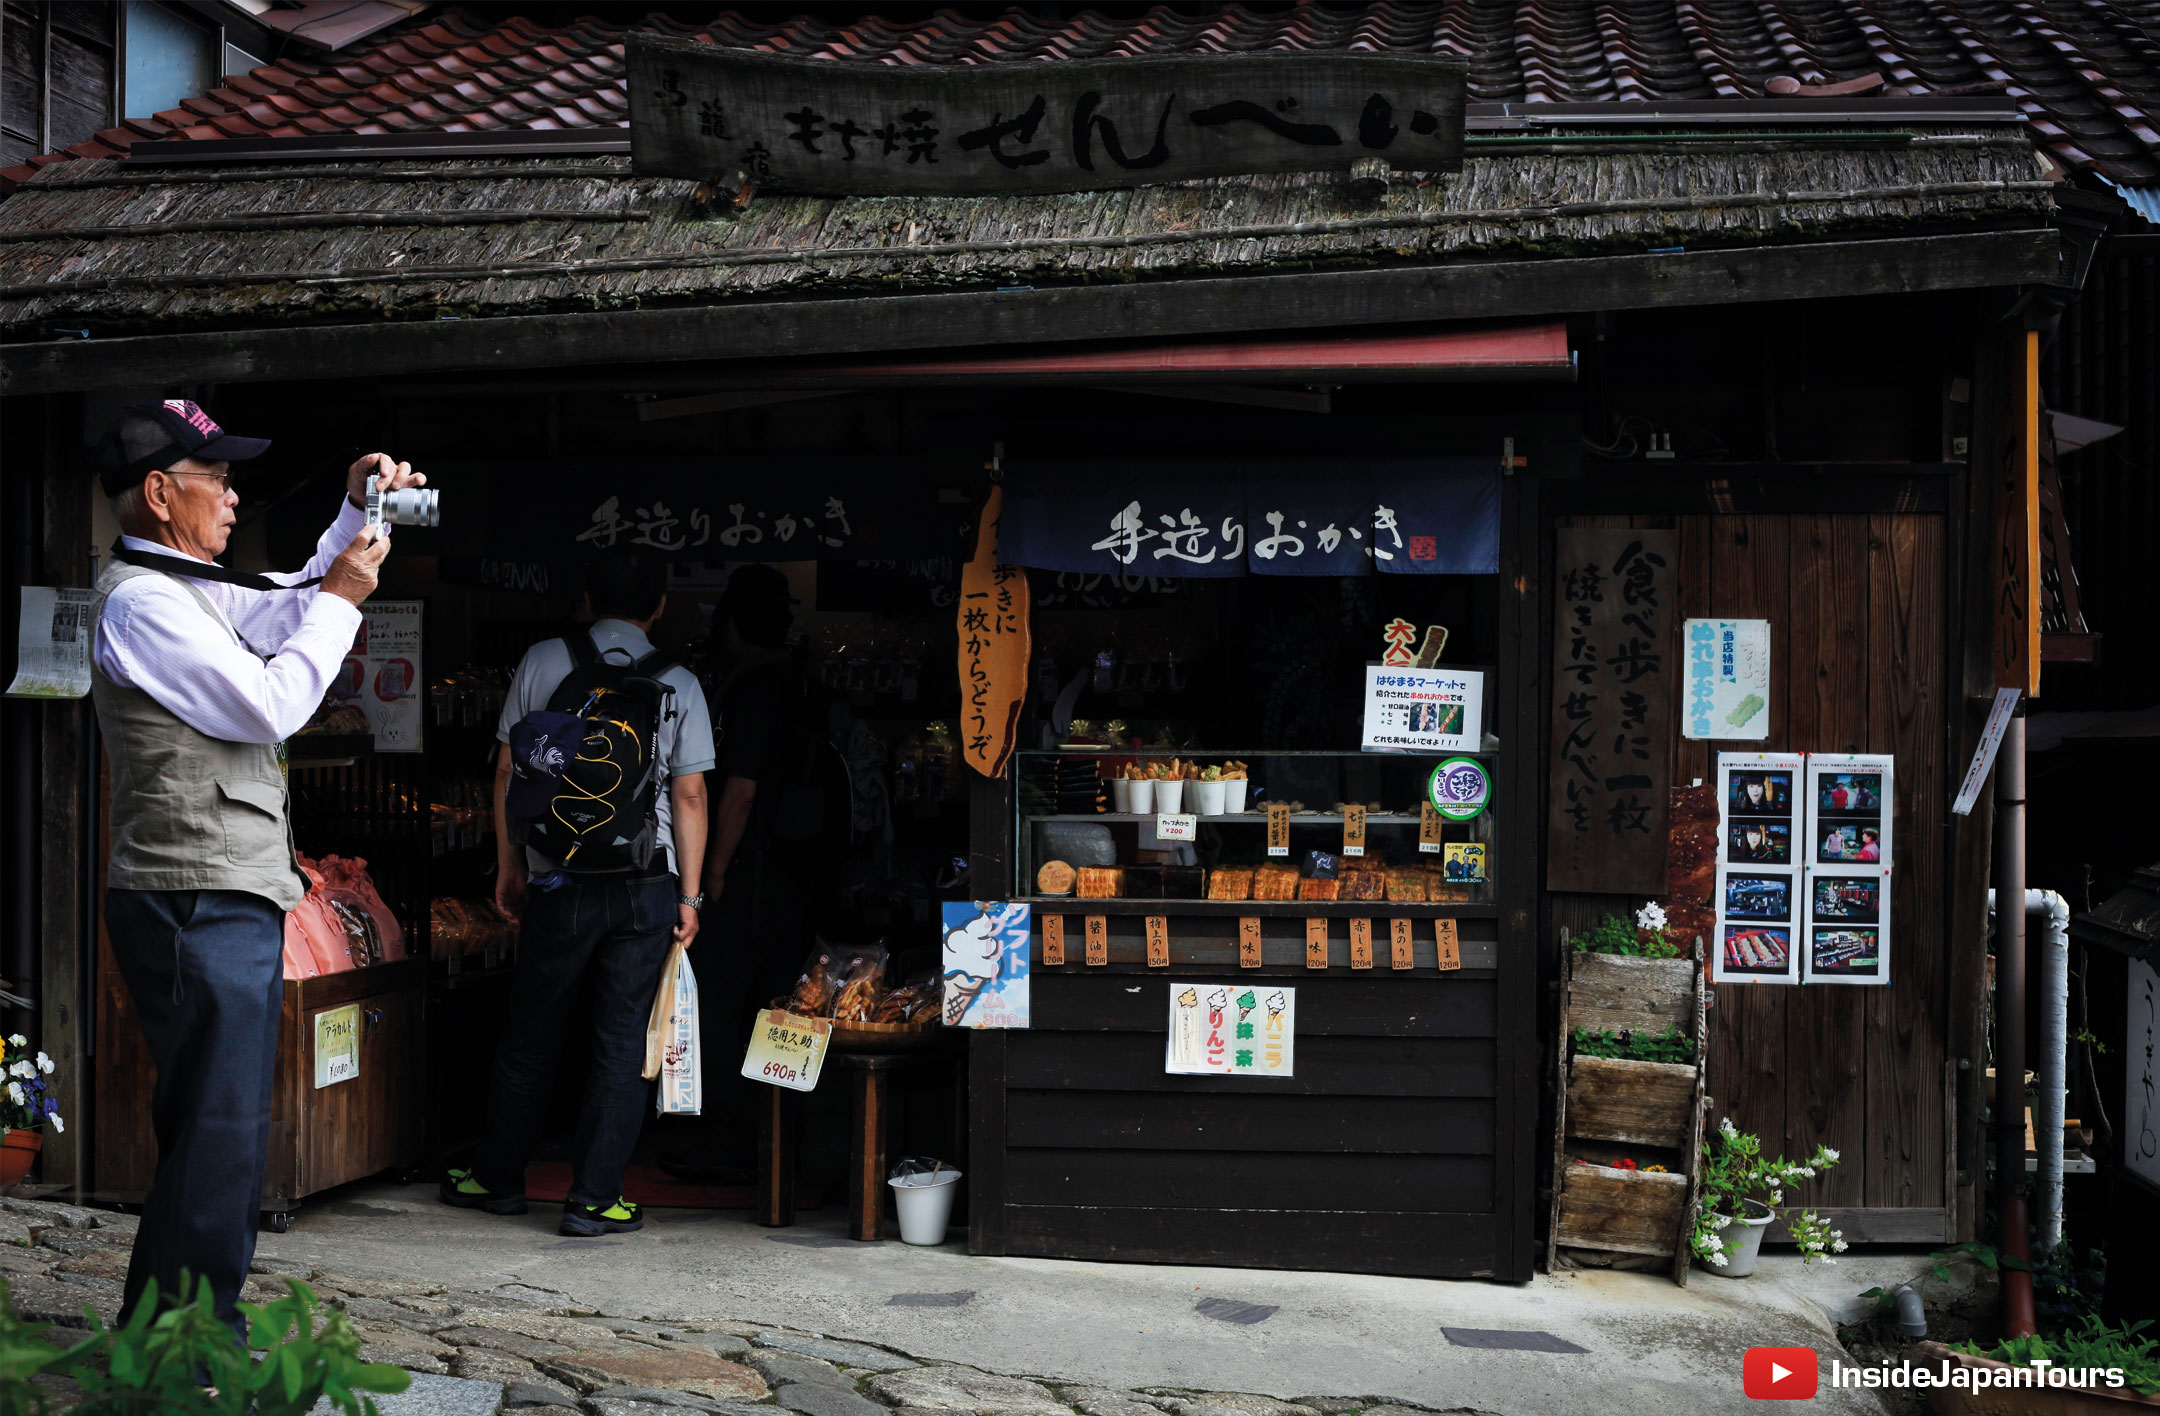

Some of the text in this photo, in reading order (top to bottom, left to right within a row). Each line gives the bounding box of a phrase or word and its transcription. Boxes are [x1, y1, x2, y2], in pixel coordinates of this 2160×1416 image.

[786, 91, 1439, 171] もち焼 せんべい
[576, 496, 853, 551] 手造りおかき
[1091, 500, 1404, 565] 手造りおかき
[1722, 630, 1734, 676] 当店特製
[963, 592, 992, 760] 一枚からどうぞ
[1376, 675, 1466, 690] はなまるマーケットで
[1605, 540, 1666, 835] 食べ歩きに一枚
[1347, 811, 1359, 840] 七味
[1007, 905, 1029, 974] ソフト
[1048, 918, 1058, 952] ざらめ
[1090, 920, 1102, 951] 醤油
[1149, 918, 1162, 956] 特上のり
[1242, 923, 1255, 953] 七味
[1308, 926, 1322, 953] 一味
[1354, 920, 1366, 957] 赤しそ
[1395, 921, 1408, 957] 青のり
[1442, 921, 1455, 958] 黒ごま
[983, 916, 1006, 1009] クリーム
[1044, 956, 1063, 964] 120円
[1086, 956, 1106, 964] 120円
[1148, 957, 1168, 966] 150円
[1241, 959, 1260, 967] 120円
[1307, 959, 1327, 967] 120円
[1352, 960, 1372, 968] 120円
[1440, 961, 1460, 969] 120円
[983, 1013, 1028, 1027] 300円
[1207, 1012, 1225, 1066] りんご
[1236, 1022, 1254, 1067] 抹茶
[1265, 1014, 1285, 1068] バニラ
[763, 1061, 797, 1081] 690円
